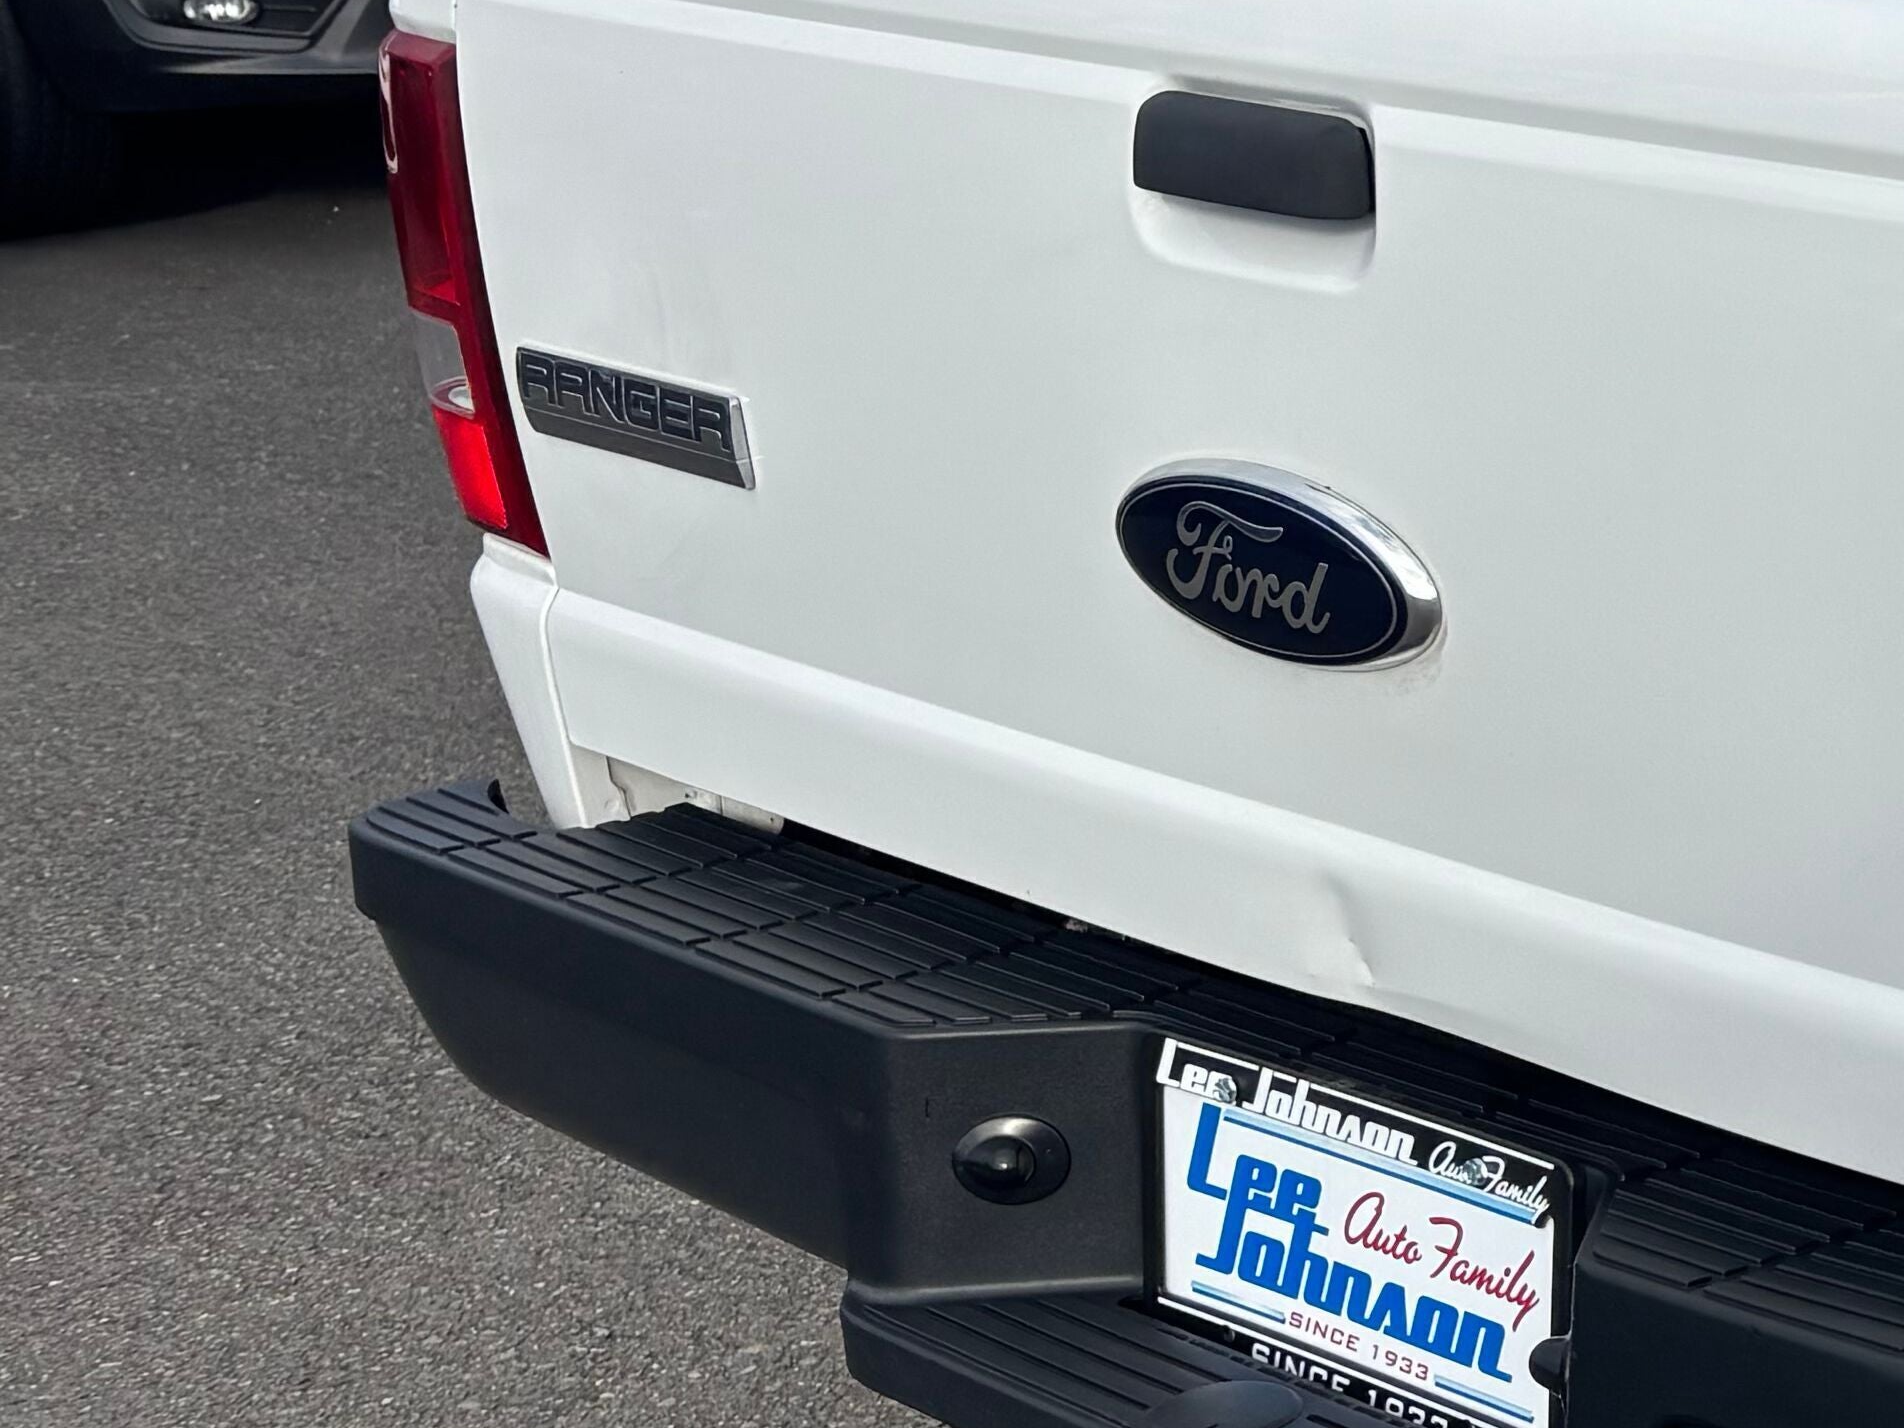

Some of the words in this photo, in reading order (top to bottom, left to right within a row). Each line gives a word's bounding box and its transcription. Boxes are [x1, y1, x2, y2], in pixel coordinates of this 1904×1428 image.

[519, 350, 732, 453] RANGER
[1164, 499, 1333, 640] Ford
[1187, 1103, 1322, 1219] Lee
[1241, 1067, 1418, 1166] Johnson
[1429, 1141, 1476, 1184] Aut
[1482, 1155, 1550, 1225] Family
[1195, 1206, 1513, 1383] Johnson
[1344, 1192, 1422, 1265] Auto
[1429, 1217, 1540, 1332] Family
[1289, 1312, 1360, 1353] SINCE
[1372, 1345, 1430, 1380] 1933
